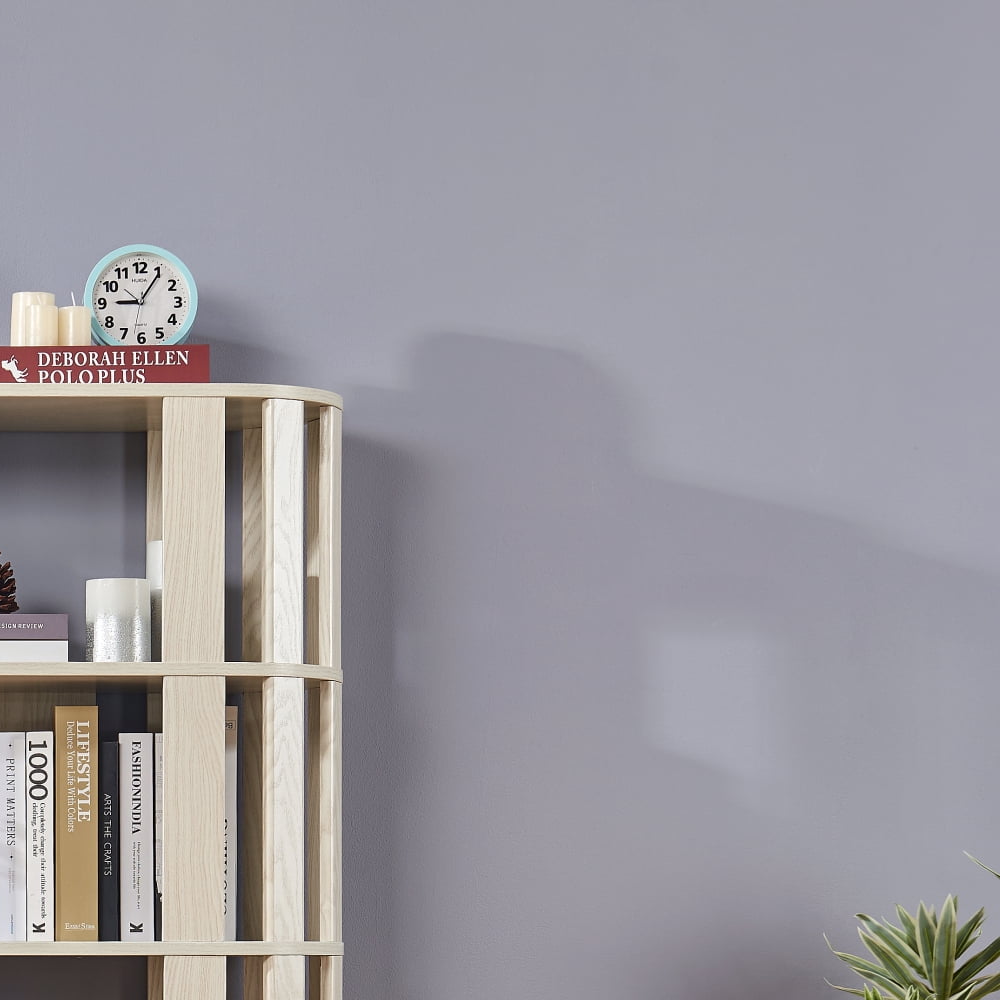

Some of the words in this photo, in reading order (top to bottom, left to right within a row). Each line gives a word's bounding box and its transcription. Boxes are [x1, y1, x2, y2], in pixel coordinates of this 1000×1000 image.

[114, 268, 128, 280] 11
[132, 262, 148, 274] 12
[154, 266, 162, 278] 1
[102, 281, 118, 292] 10
[168, 280, 177, 291] 2
[98, 298, 106, 310] 9
[174, 296, 182, 308] 3
[105, 316, 114, 328] 8
[168, 314, 178, 326] 4
[120, 328, 128, 340] 7
[137, 332, 146, 344] 6
[156, 328, 164, 339] 5
[38, 352, 128, 366] DEBORAH
[132, 350, 189, 366] ELLEN
[38, 370, 93, 383] POLO
[98, 369, 146, 384] PLUS
[66, 722, 76, 750] Deduce
[67, 750, 76, 770] Your
[6, 758, 15, 792] PRINT
[29, 740, 48, 800] 1000
[77, 720, 90, 822] LIFESTYLE
[67, 771, 76, 786] Life
[132, 742, 142, 834] FASHIONINDIA
[68, 788, 76, 806] With
[6, 798, 16, 846] MATTERS
[68, 808, 76, 832] Colors
[104, 820, 112, 838] THE
[104, 842, 112, 876] CRAFTS
[32, 923, 46, 932] K
[130, 923, 143, 933] K
